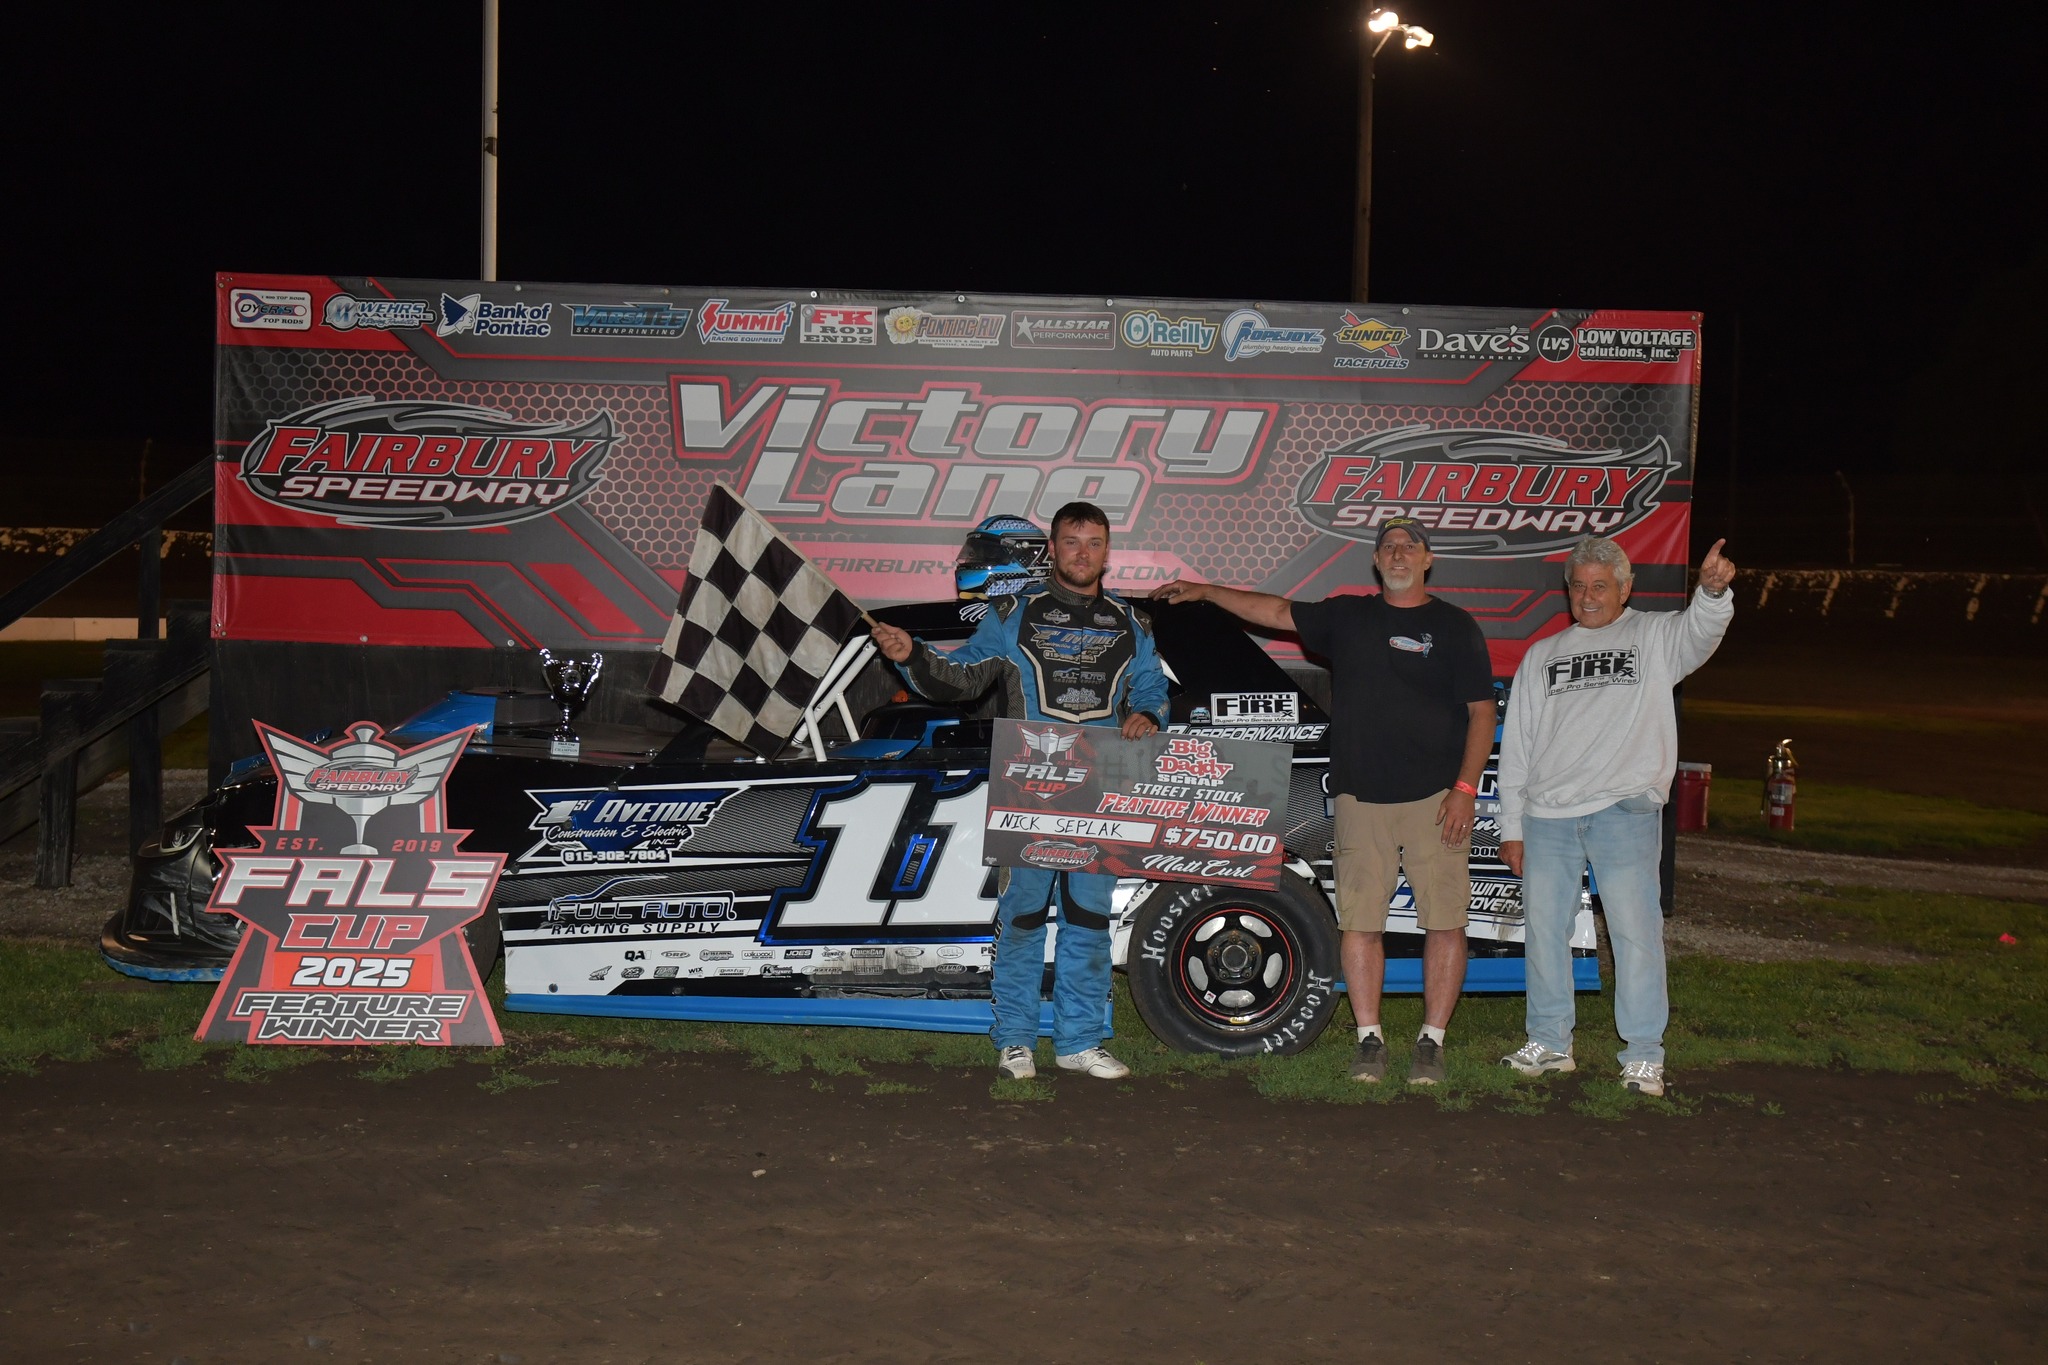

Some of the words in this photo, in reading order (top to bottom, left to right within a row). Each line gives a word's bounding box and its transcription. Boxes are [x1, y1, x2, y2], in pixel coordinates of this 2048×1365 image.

[353, 312, 433, 320] MACHINE
[360, 303, 425, 314] WEHRS
[478, 303, 527, 319] Bank
[526, 304, 551, 320] of
[811, 309, 874, 326] FK
[1031, 319, 1110, 330] ALLSTAR
[475, 321, 550, 336] Pontiac
[576, 327, 676, 336] SCREENPRINTING
[819, 325, 874, 335] ROD
[915, 315, 978, 338] PONTIAC
[975, 315, 1004, 339] RV
[1033, 331, 1110, 340] PERFORMANCE
[1125, 312, 1215, 350] O'Reilly
[1339, 328, 1403, 342] SUNOCO
[803, 334, 874, 344] ENDS
[1417, 325, 1530, 352] Dave's
[1542, 337, 1570, 351] LVS
[1578, 329, 1616, 345] LOW
[1620, 330, 1693, 346] VOLTAGE
[1423, 353, 1523, 361] SUPERMARKET
[1579, 346, 1647, 359] solutions,
[1335, 358, 1370, 368] RACE
[1370, 359, 1409, 369] FUELS
[680, 384, 1265, 474] Victory
[255, 425, 600, 480] FAIRBURY
[742, 451, 1146, 520] Lane
[1311, 455, 1658, 508] FAIRBURY
[278, 477, 570, 504] SPEEDWAY
[1331, 505, 1625, 532] SPEEDWAY
[1572, 652, 1629, 663] MULT
[1548, 654, 1634, 688] FIRE
[1217, 698, 1293, 717] FIRE
[1169, 738, 1213, 759] Big
[309, 768, 413, 784] FAIRBURY
[1005, 763, 1088, 783] FALS
[1155, 756, 1234, 780] Daddy
[315, 783, 406, 791] SPEEDWAY
[1024, 781, 1067, 793] CUP
[1157, 774, 1224, 787] SCRAP
[1132, 783, 1190, 798] STREET
[1194, 788, 1245, 803] STOCK
[593, 800, 716, 823] AVENUE
[1096, 792, 1191, 820] FEATURE
[1187, 801, 1271, 828] WINNER
[548, 825, 618, 839] Construction
[621, 825, 639, 838] &
[641, 824, 689, 838] Electric
[1000, 813, 1041, 831] NICK
[1054, 818, 1124, 838] SEPLAK
[276, 837, 324, 851] EST.
[391, 839, 442, 852] 2019
[1163, 825, 1277, 855] $750.00
[564, 850, 667, 862] 815-302-7804
[776, 782, 998, 927] 11
[1025, 845, 1093, 860] FAIRBURY
[1028, 855, 1087, 865] SPEEDWAY
[1142, 854, 1201, 874] Matt
[1200, 860, 1257, 878] Curl
[216, 857, 497, 908] FALS
[554, 902, 633, 920] FULL
[641, 902, 725, 919] AUTO
[280, 914, 430, 950] CUP
[551, 922, 630, 936] RACING
[642, 922, 721, 934] SUPPLY
[291, 957, 415, 987] 2025
[688, 966, 704, 974] WIX
[234, 993, 467, 1018] FEATURE
[1262, 969, 1333, 1054] Hoosier
[257, 1017, 443, 1040] WINNER
